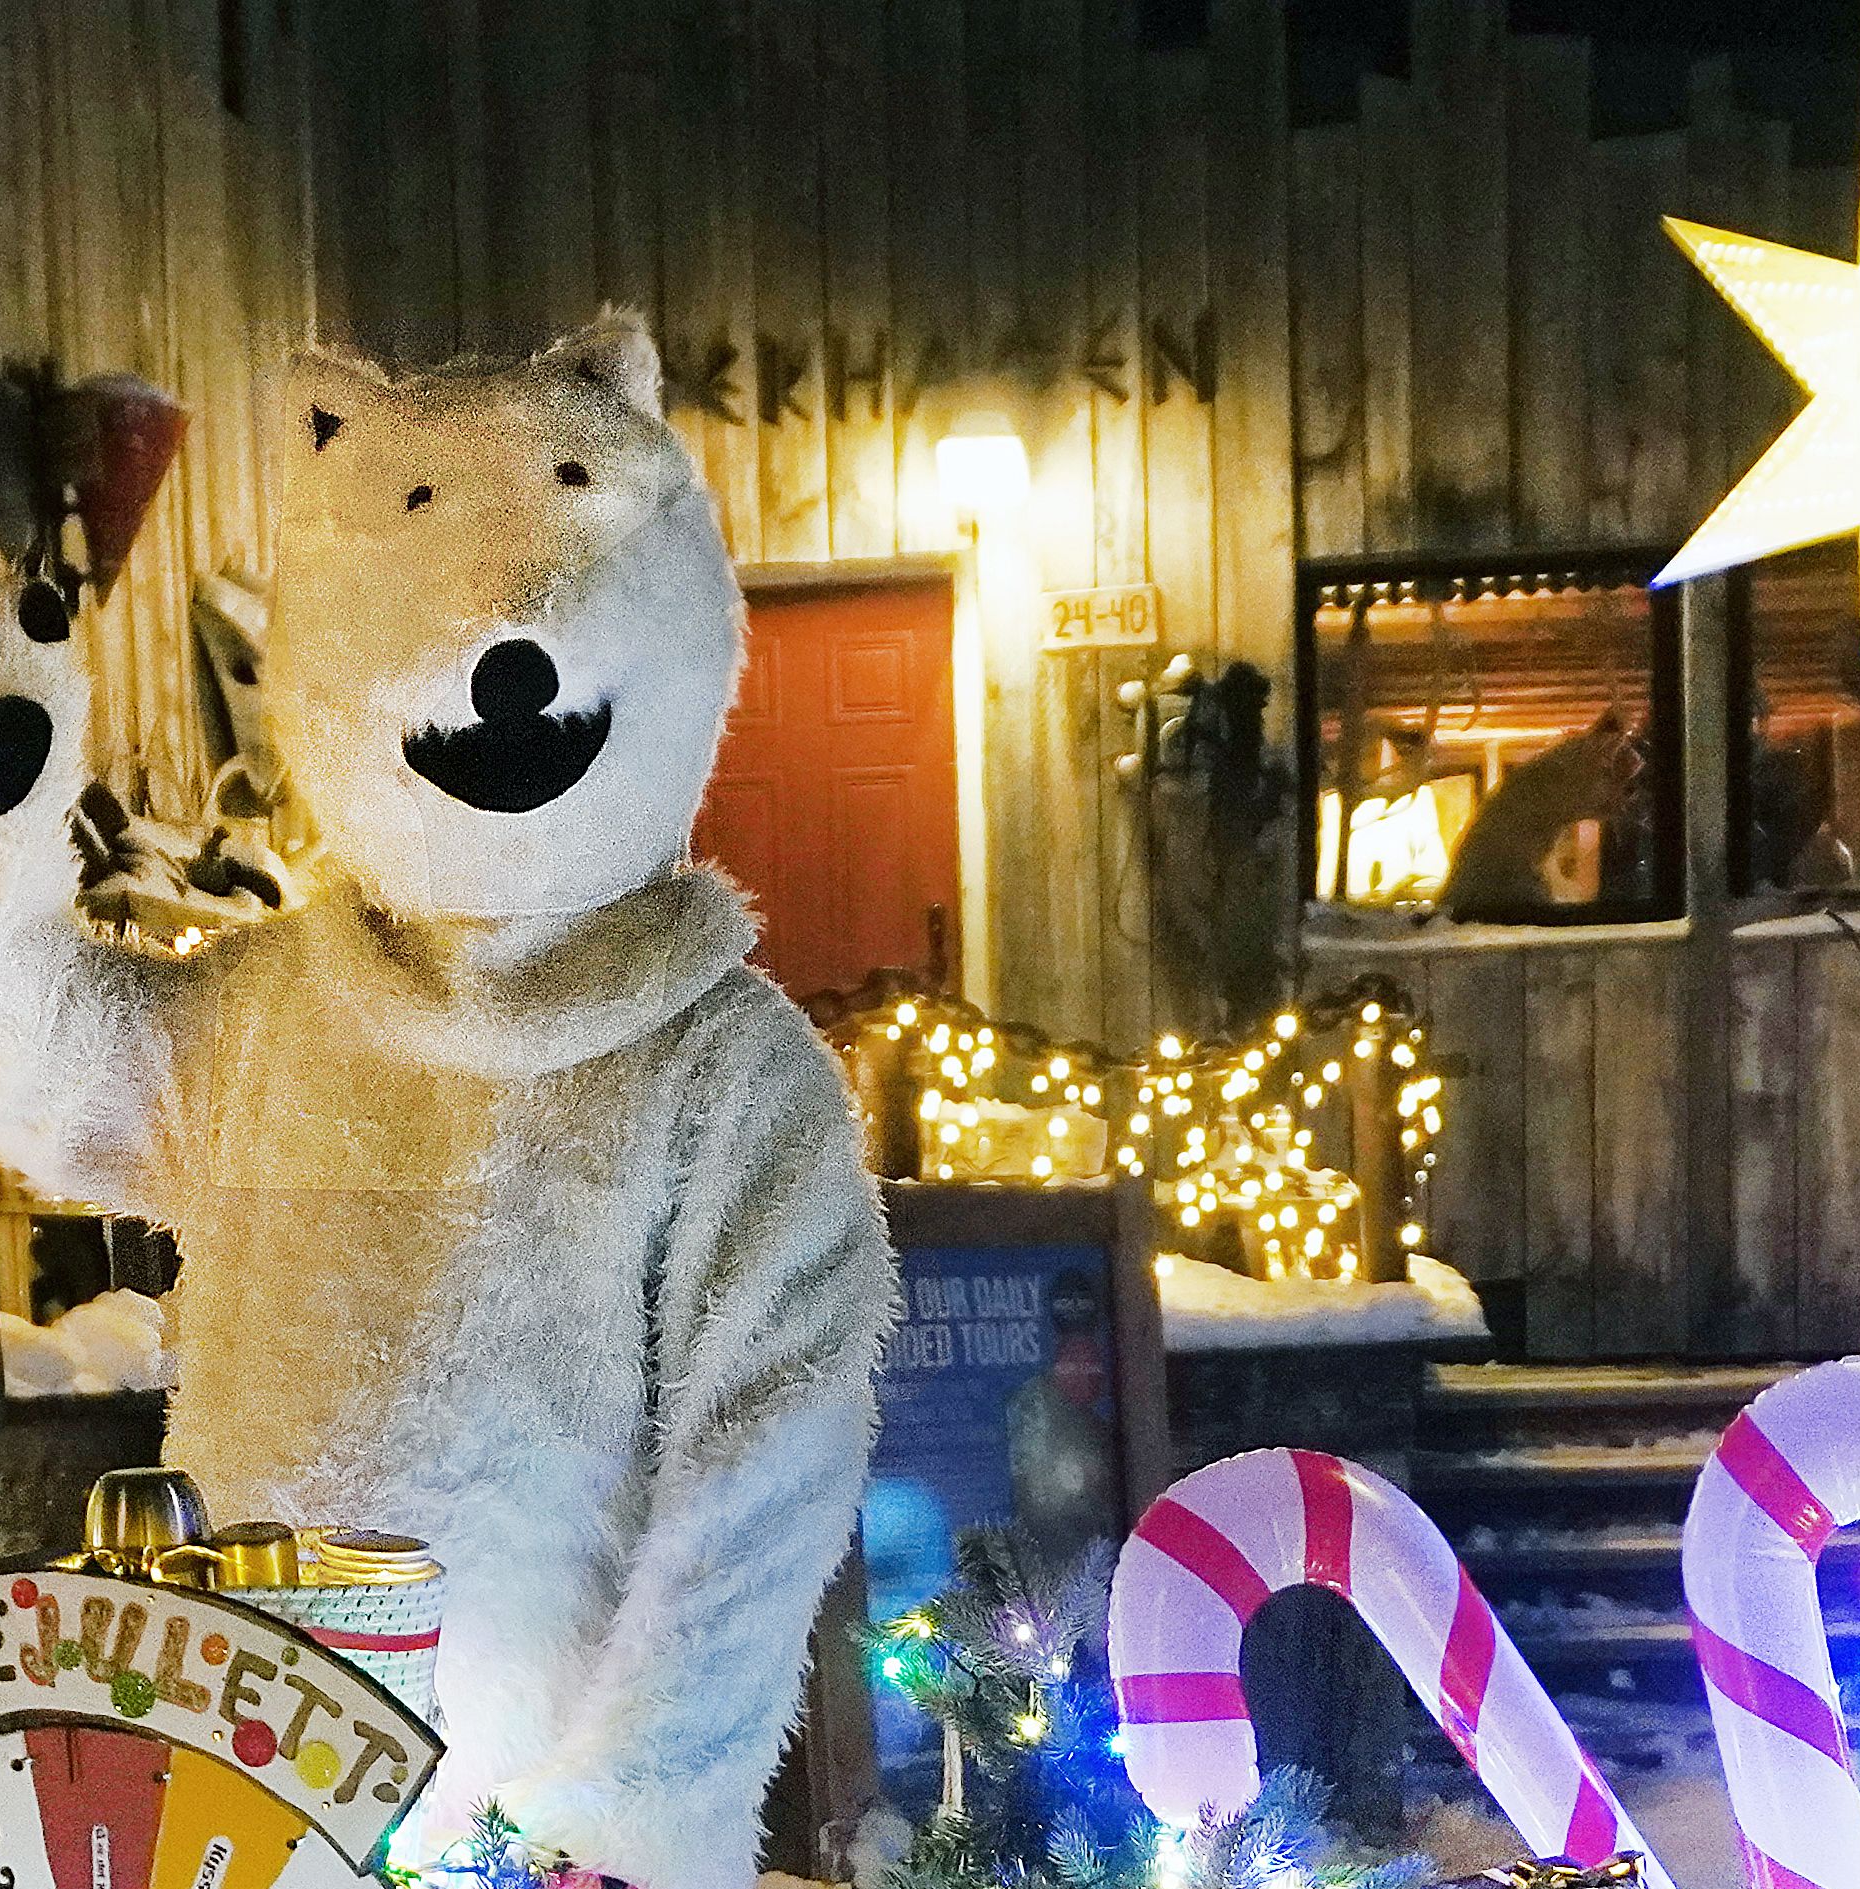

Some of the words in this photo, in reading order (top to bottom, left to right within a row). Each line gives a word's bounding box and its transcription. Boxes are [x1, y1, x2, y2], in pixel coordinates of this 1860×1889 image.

[1052, 594, 1148, 638] 24-40
[915, 1276, 971, 1320] OUR
[973, 1273, 1040, 1318] DAILY
[960, 1320, 1041, 1366] TOURS
